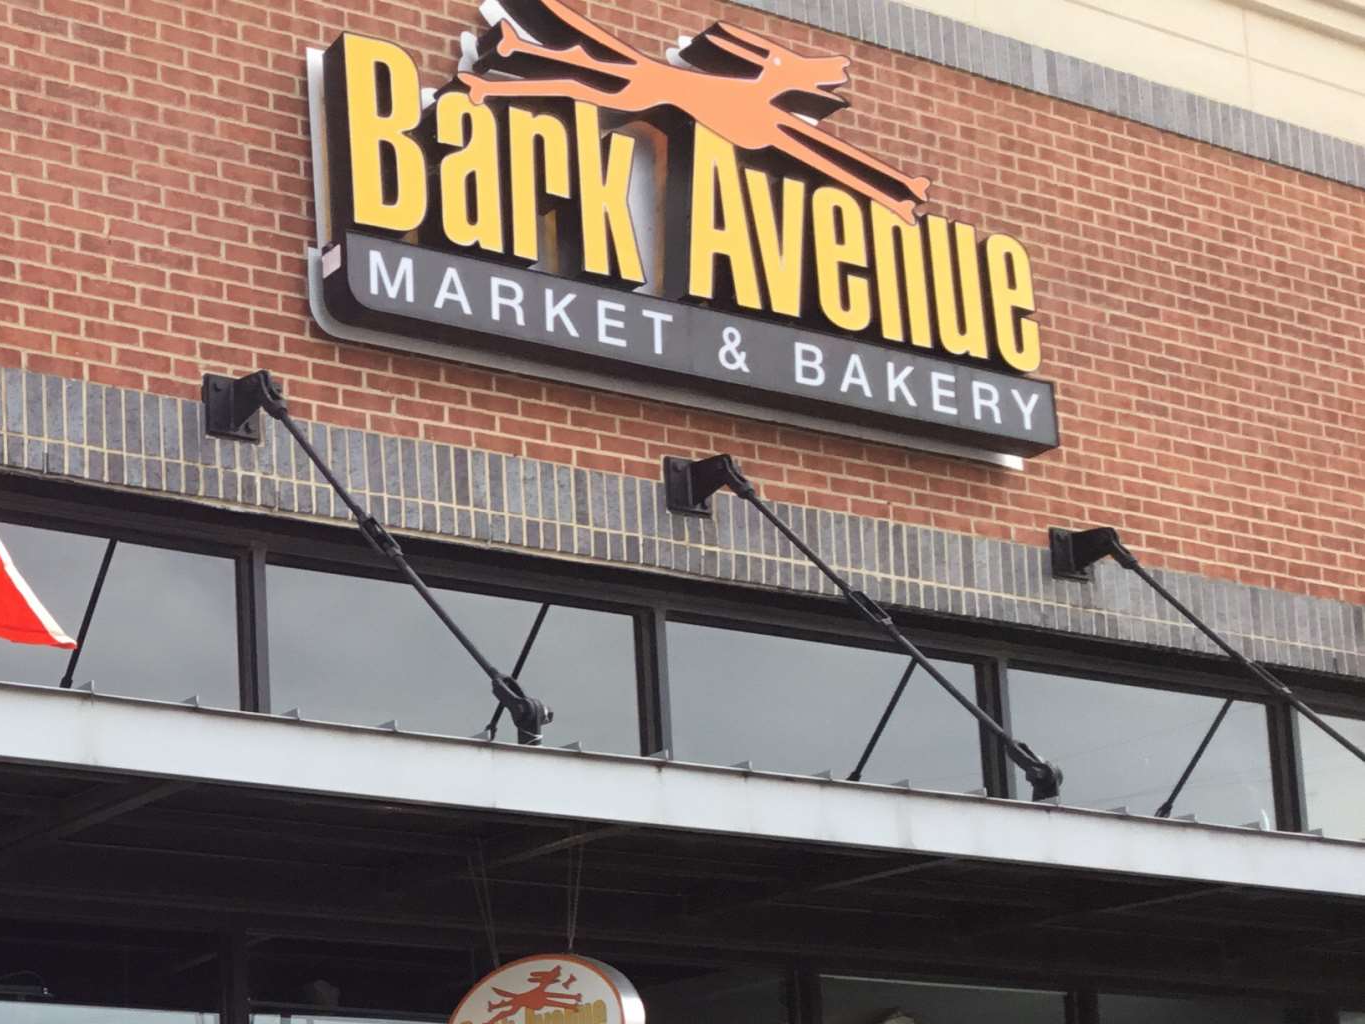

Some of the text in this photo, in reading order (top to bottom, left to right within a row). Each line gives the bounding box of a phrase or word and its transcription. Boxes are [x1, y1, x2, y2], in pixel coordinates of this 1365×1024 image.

[342, 33, 1041, 372] Bark Avenue
[367, 250, 1040, 431] MARKET & BAKERY
